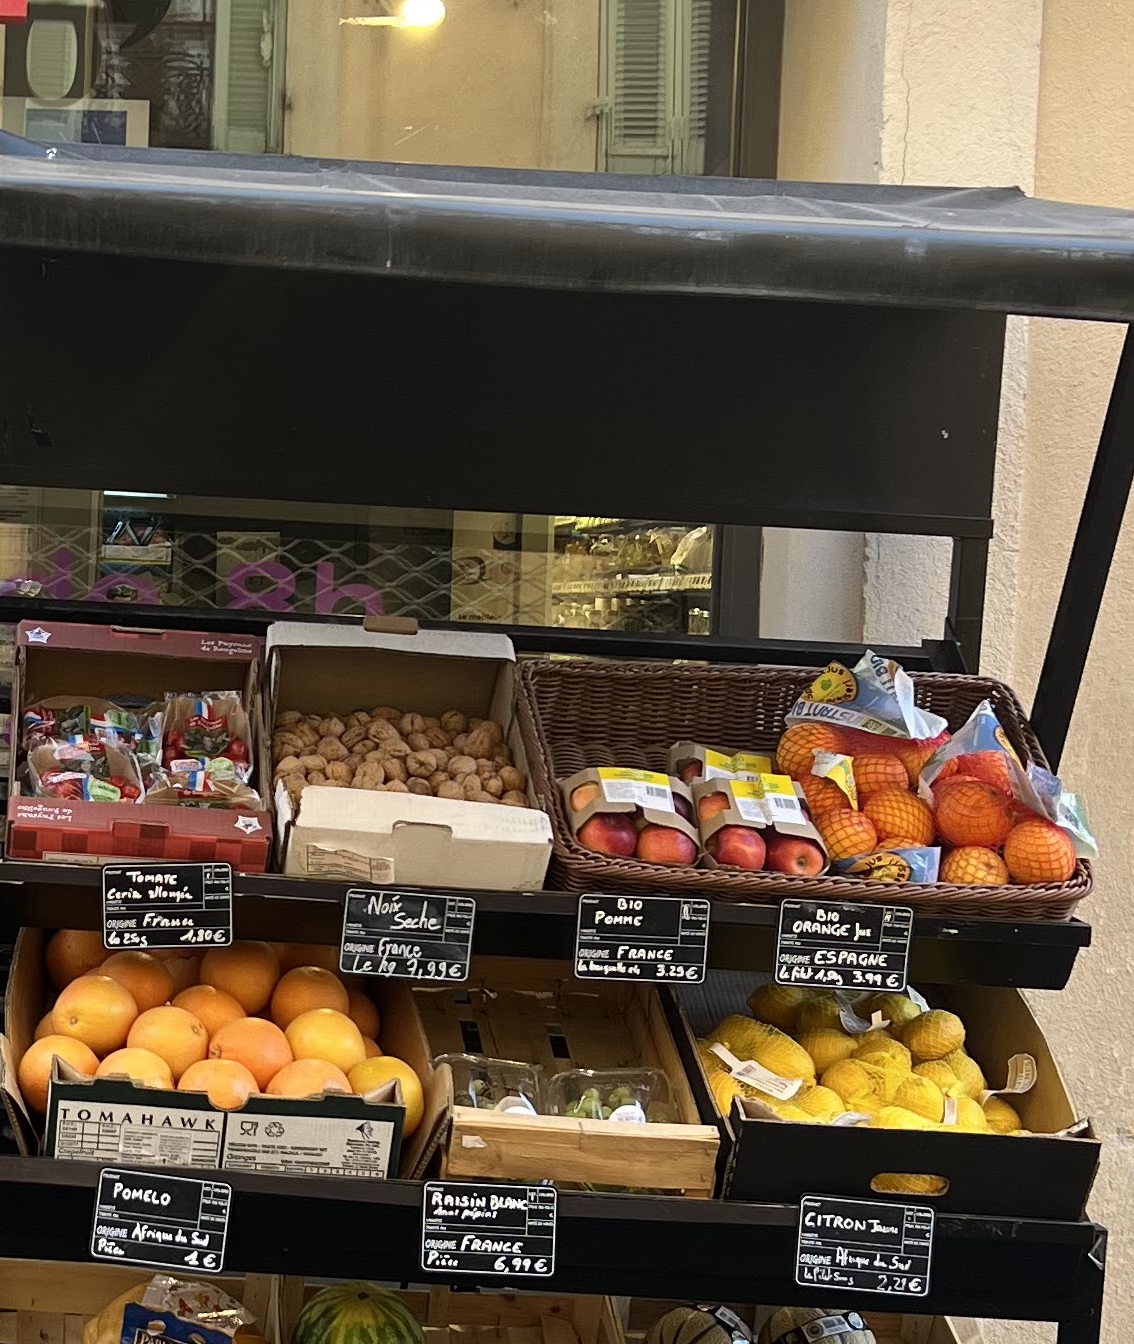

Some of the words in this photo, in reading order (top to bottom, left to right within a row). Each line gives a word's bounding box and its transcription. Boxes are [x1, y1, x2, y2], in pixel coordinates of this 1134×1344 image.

[126, 871, 178, 885] TOMATE
[618, 898, 642, 910] BIO
[595, 911, 643, 926] POMME
[817, 909, 840, 922] BIO
[793, 921, 851, 936] ORANGE
[378, 938, 422, 958] France
[617, 946, 674, 960] FRANCE
[814, 951, 888, 967] ESPAGNE
[61, 1108, 216, 1130] TOMAHAWK
[114, 1182, 171, 1206] POMELO
[804, 1212, 866, 1231] CITRON
[460, 1235, 523, 1253] FRANCE
